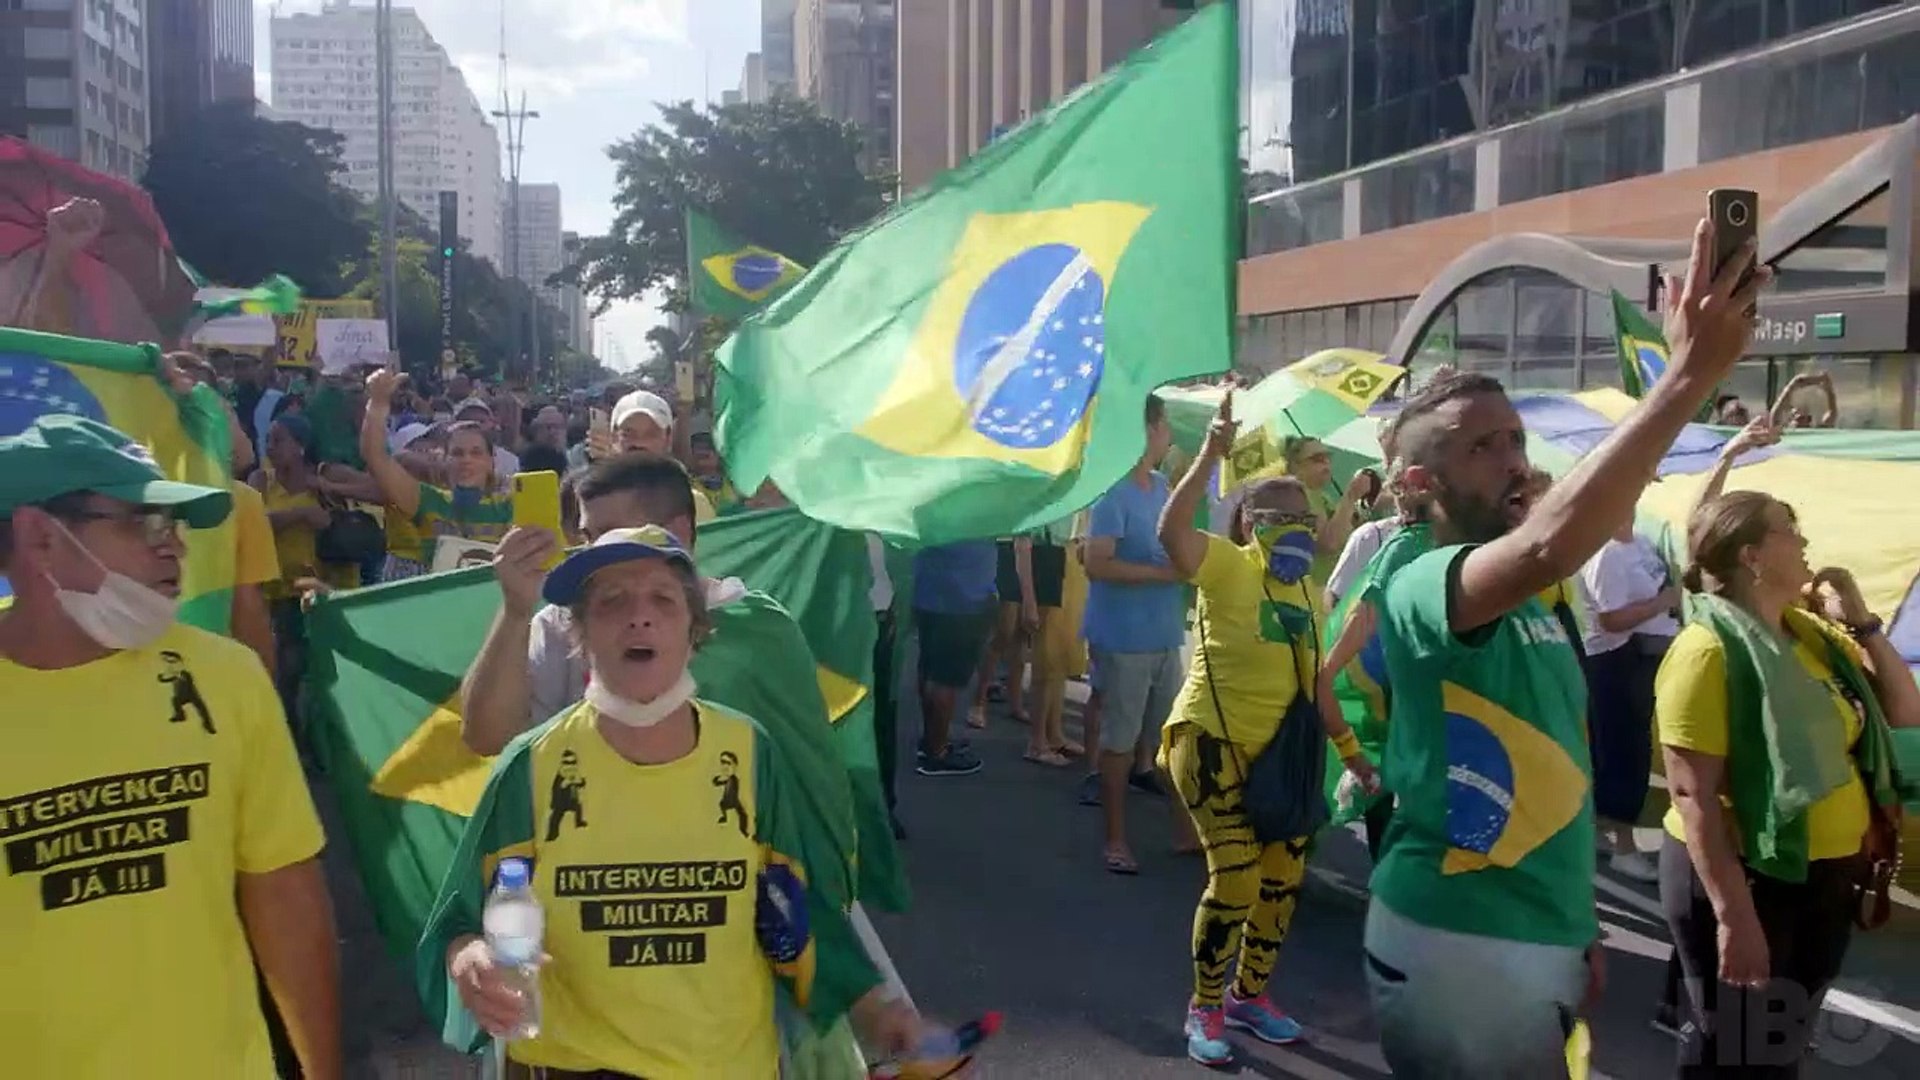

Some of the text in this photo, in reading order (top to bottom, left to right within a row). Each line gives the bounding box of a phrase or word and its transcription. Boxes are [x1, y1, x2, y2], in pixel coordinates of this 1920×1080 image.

[1754, 318, 1806, 344] Masp
[35, 817, 169, 864] MILITAR
[62, 867, 150, 903] JÁ !!!
[559, 862, 744, 891] INTERVENÇÃO
[603, 903, 708, 926] MILITAR
[624, 937, 694, 965] JÁ !!!
